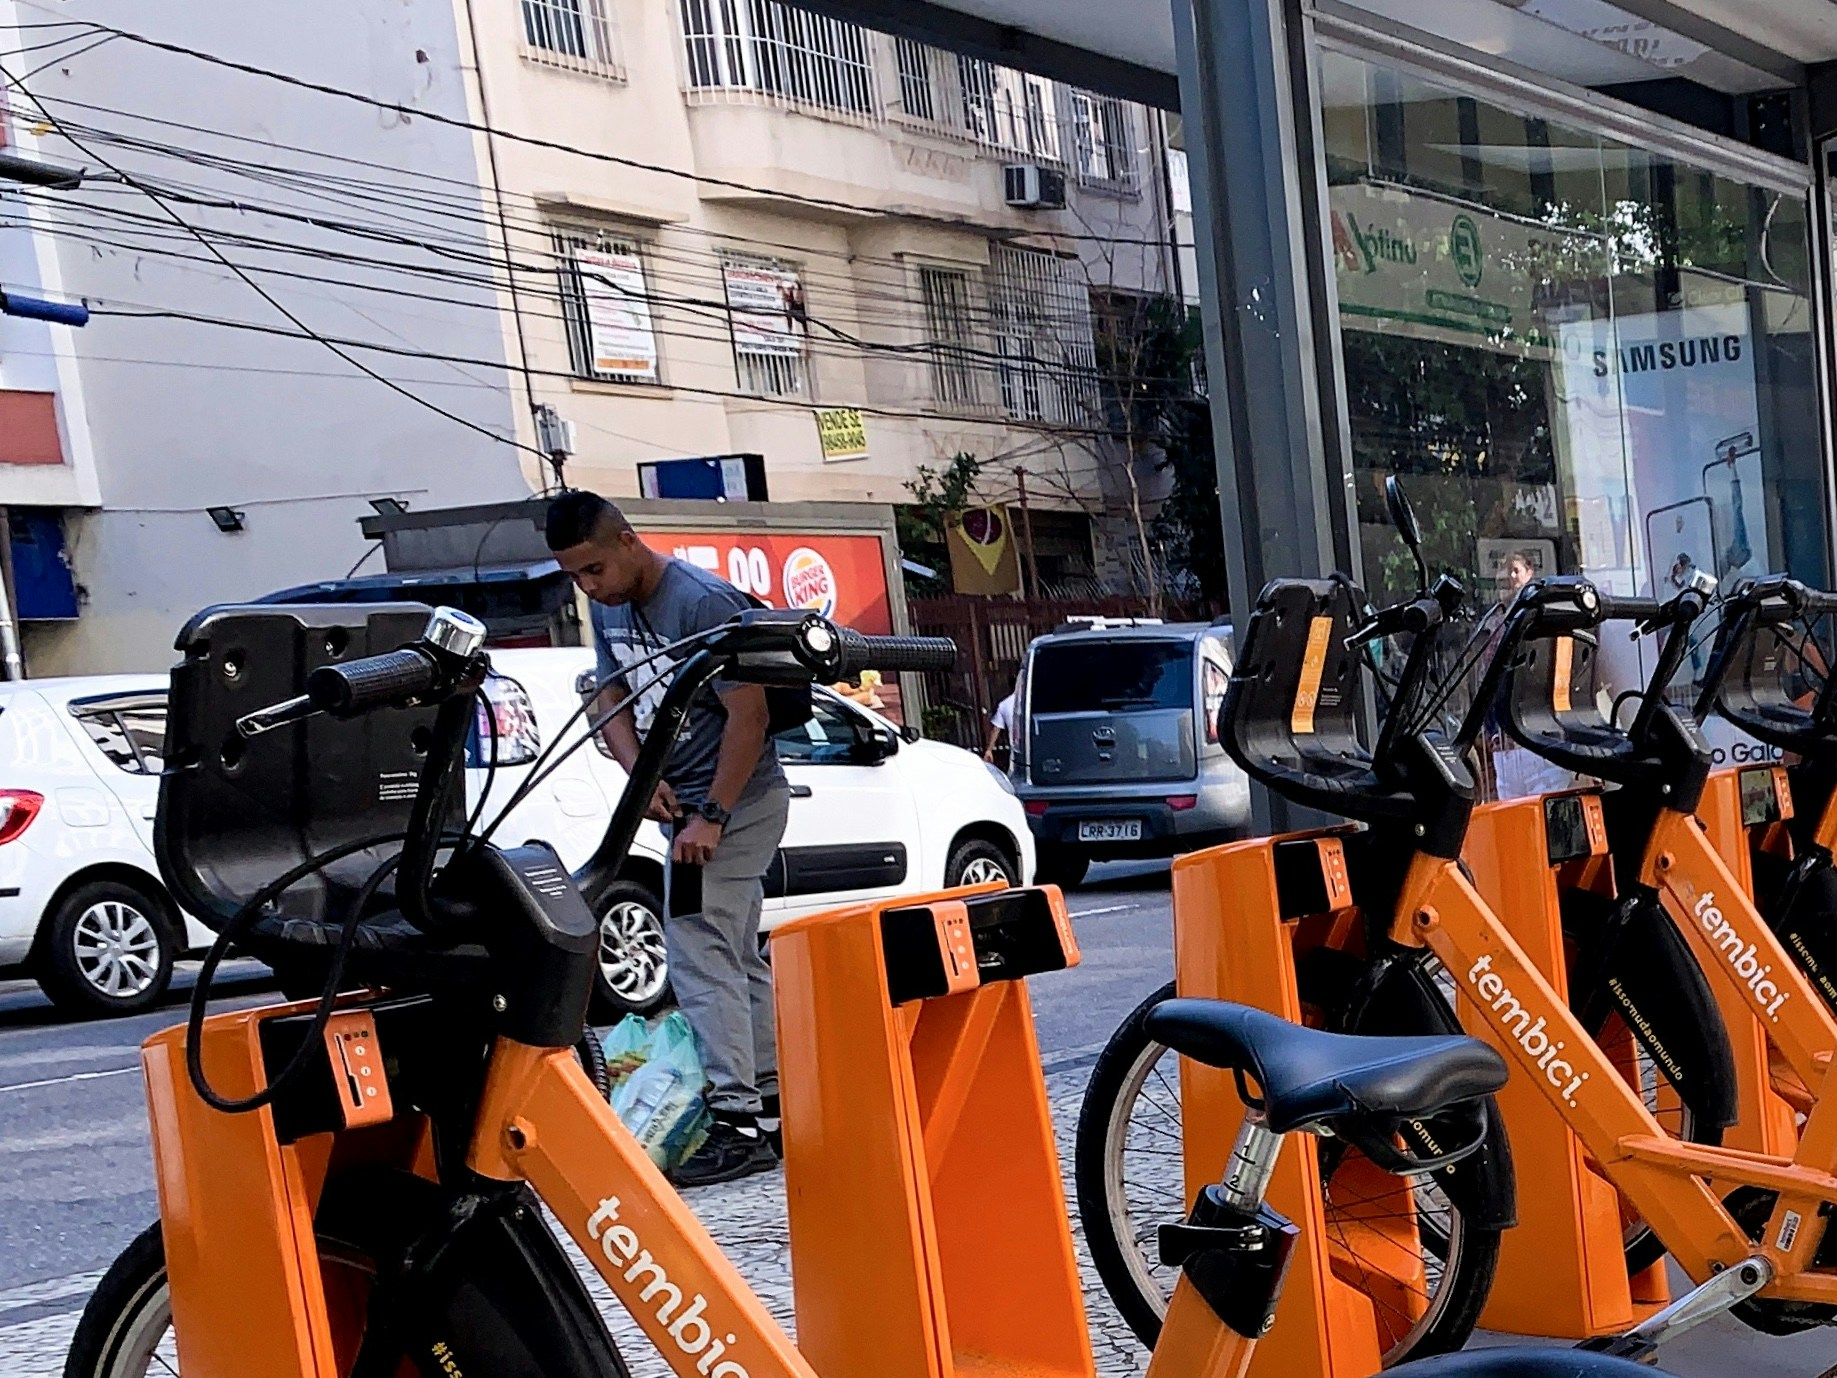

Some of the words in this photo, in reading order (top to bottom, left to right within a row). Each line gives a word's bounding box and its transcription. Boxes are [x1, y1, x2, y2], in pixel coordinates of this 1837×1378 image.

[1593, 334, 1742, 378] SAMSUNG
[790, 564, 825, 588] BURGER
[794, 577, 829, 607] KING
[1608, 976, 1684, 1082] #issomudaomundo
